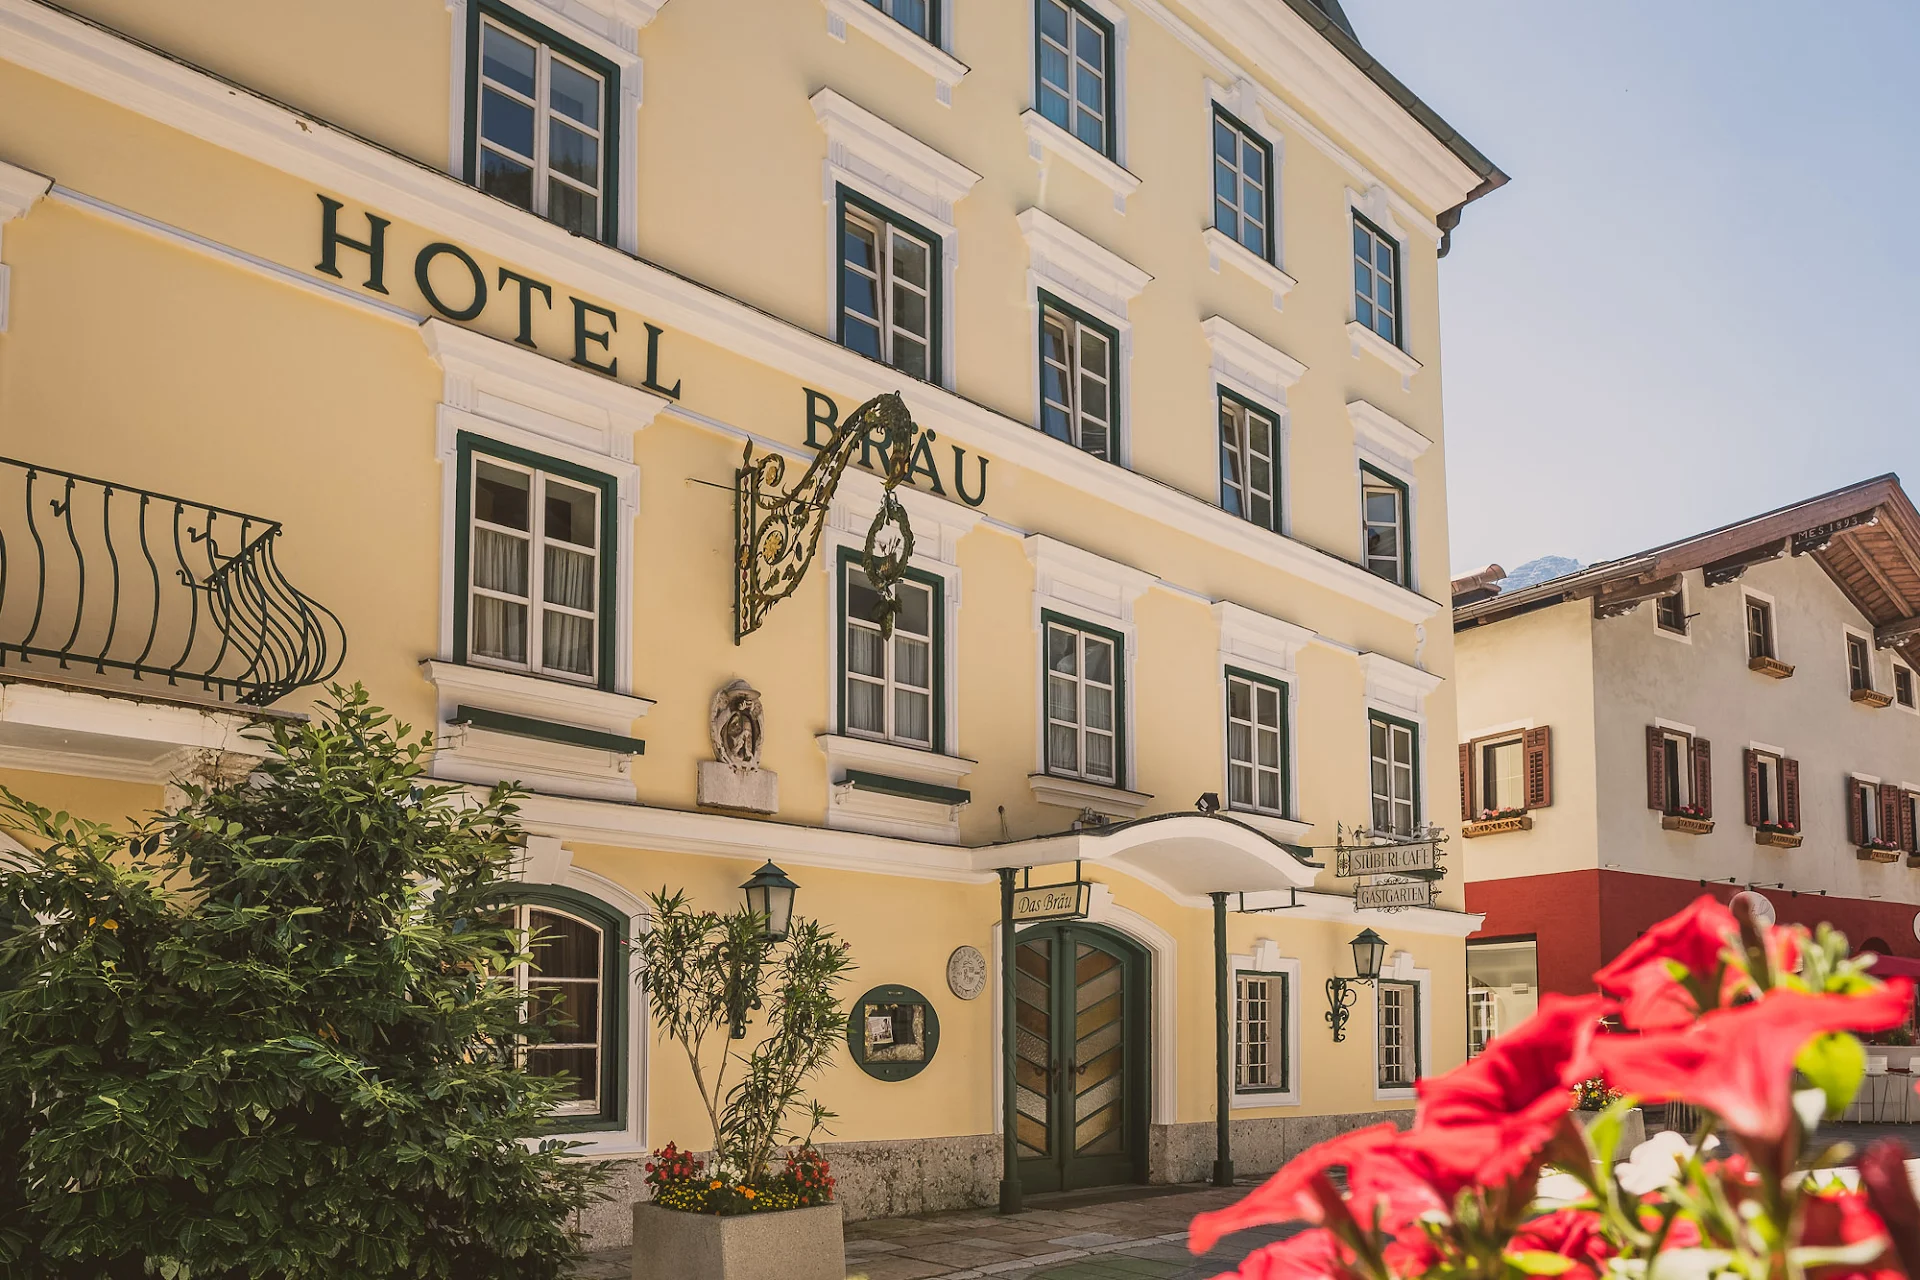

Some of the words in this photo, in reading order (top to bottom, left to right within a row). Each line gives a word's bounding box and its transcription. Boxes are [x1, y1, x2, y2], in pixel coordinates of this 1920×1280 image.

[314, 193, 682, 401] HOTEL
[1018, 896, 1042, 914] Das
[1043, 893, 1072, 911] Bräu
[1361, 887, 1425, 904] GASTGARTEN
